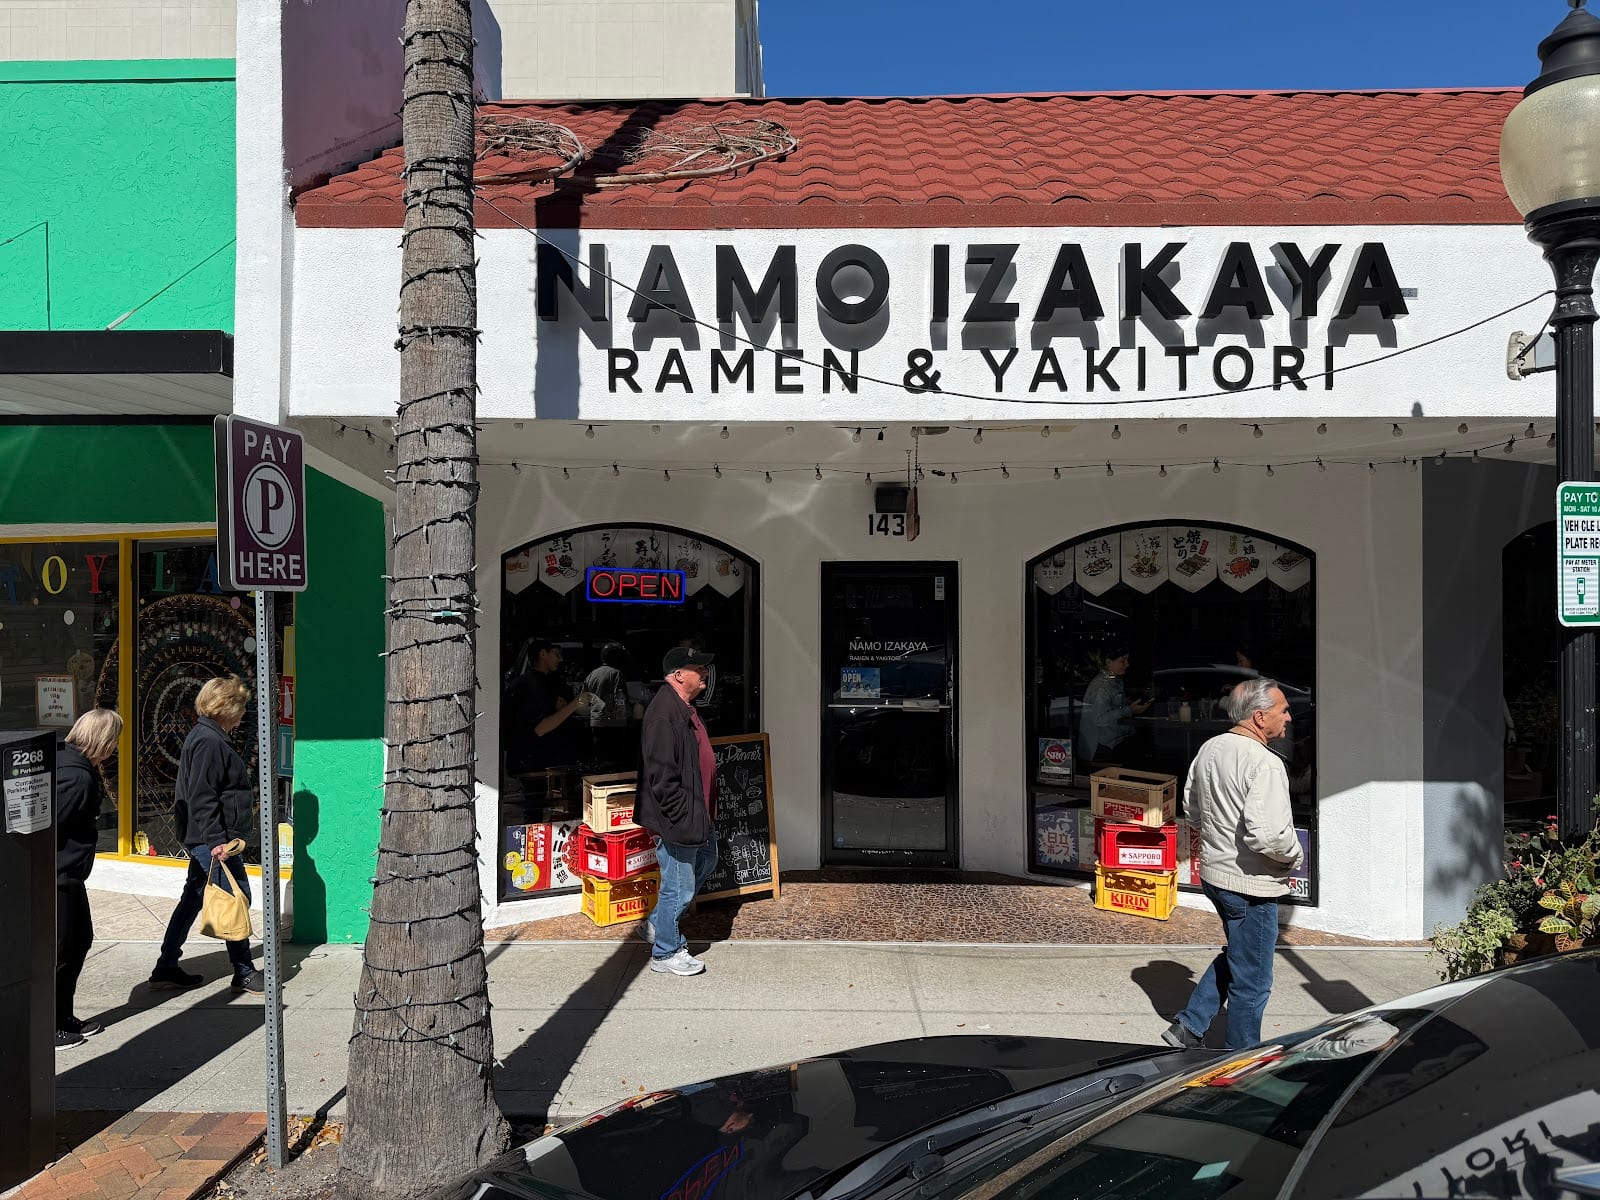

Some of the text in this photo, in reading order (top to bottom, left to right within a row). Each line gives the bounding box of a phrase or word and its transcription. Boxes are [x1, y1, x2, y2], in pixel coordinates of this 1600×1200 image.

[537, 242, 1410, 324] NAMO IZAKAYA
[608, 345, 1334, 394] RAMEN & YAKITORI
[244, 429, 291, 463] PAY
[256, 478, 284, 534] P
[1564, 492, 1598, 503] PAY TO
[868, 514, 905, 536] 143
[1564, 520, 1594, 532] VEHCLE
[1565, 537, 1588, 549] PLATE
[239, 551, 301, 580] HERE
[592, 572, 680, 599] OPEN
[849, 641, 928, 651] NAMO IZAKAYA
[842, 672, 862, 683] OPEN
[13, 750, 43, 767] 2268
[633, 852, 657, 865] SAPPOR
[1128, 852, 1161, 860] SAPPORO
[617, 898, 649, 912] KIRIN
[1111, 891, 1149, 908] KIRIN
